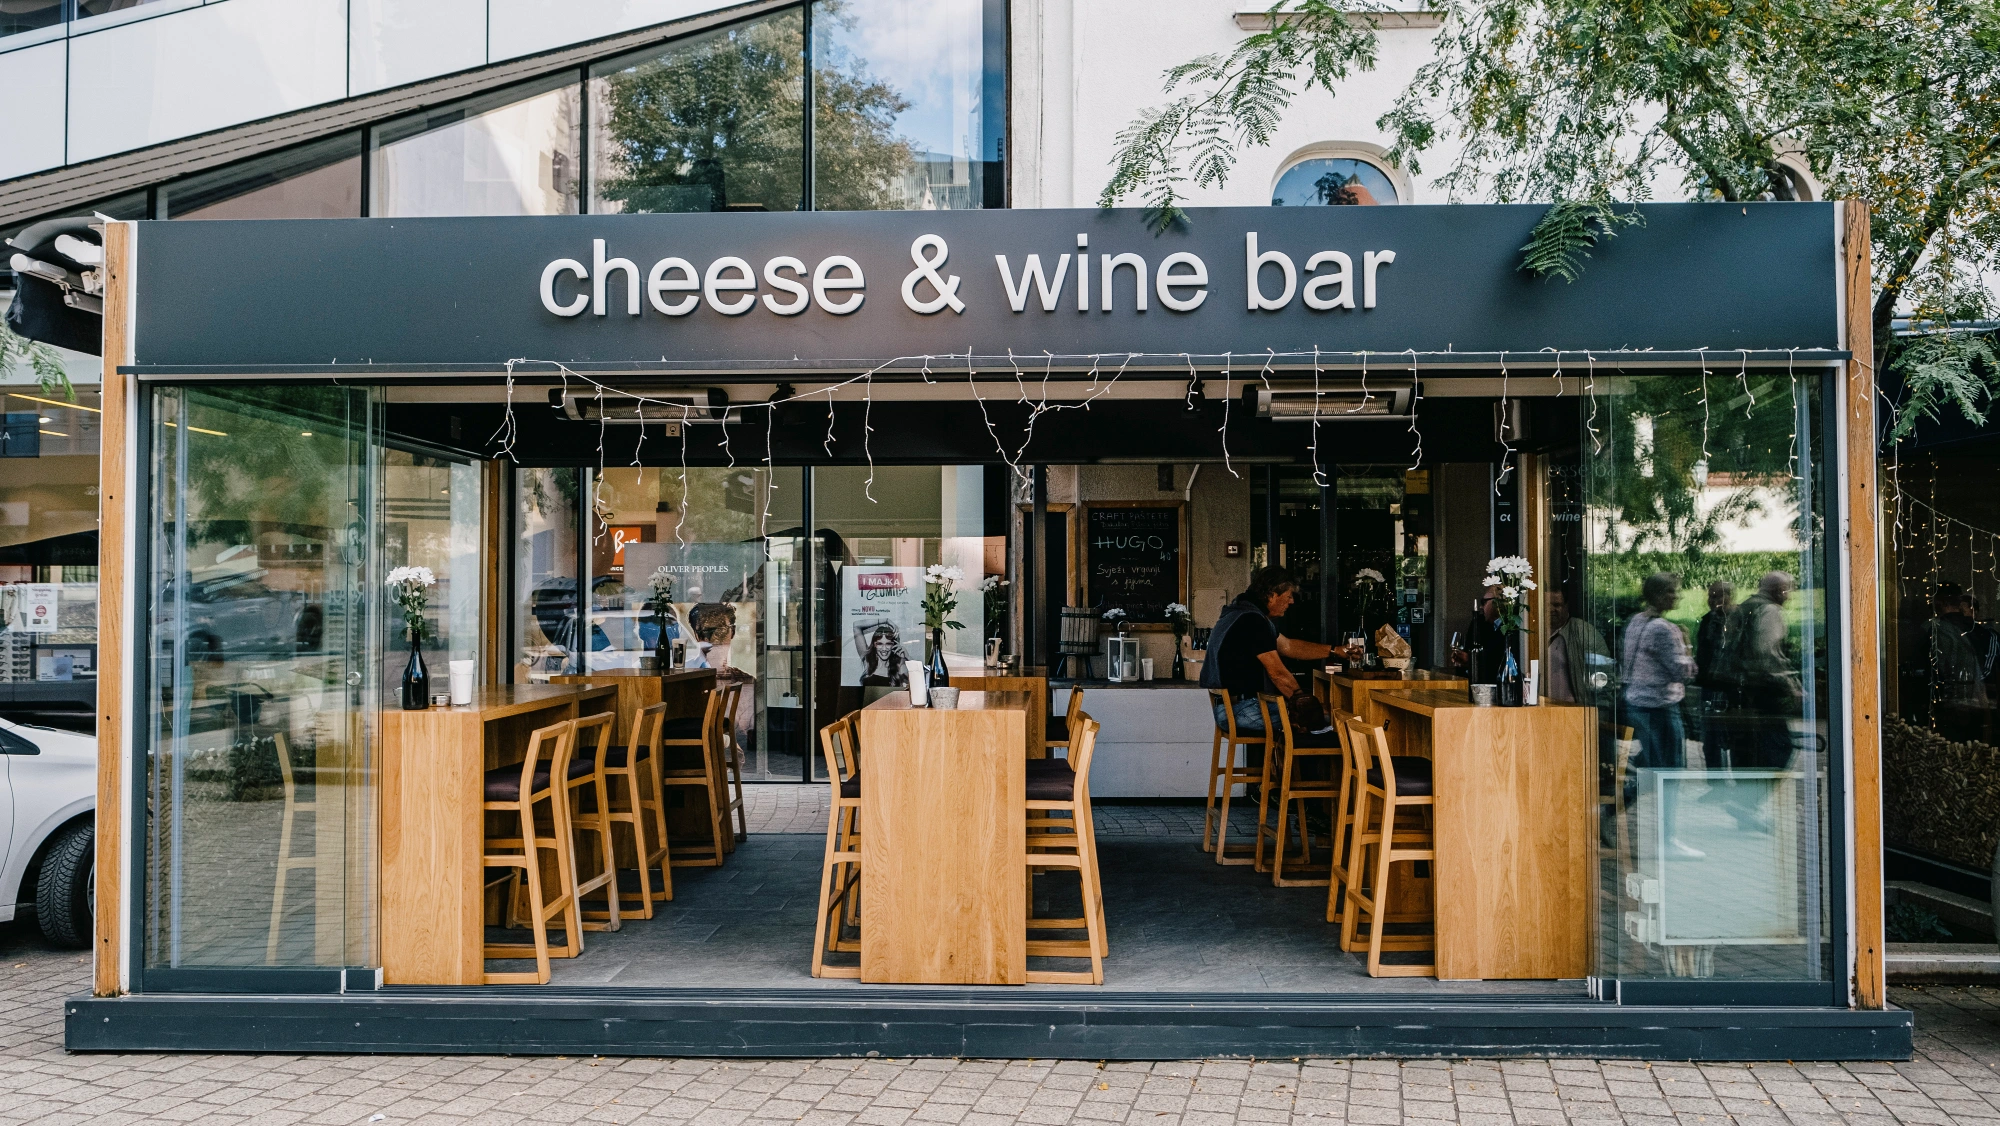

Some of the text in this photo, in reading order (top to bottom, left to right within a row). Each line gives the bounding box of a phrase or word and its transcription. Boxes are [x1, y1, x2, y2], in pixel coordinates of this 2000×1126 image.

[539, 231, 1397, 317] cheese & wine bar
[1091, 512, 1126, 521] CRAFT
[1552, 512, 1581, 522] wine
[1091, 535, 1164, 551] HUGO
[657, 565, 729, 573] OLIVER PEOPLES
[868, 577, 901, 586] MAJKA
